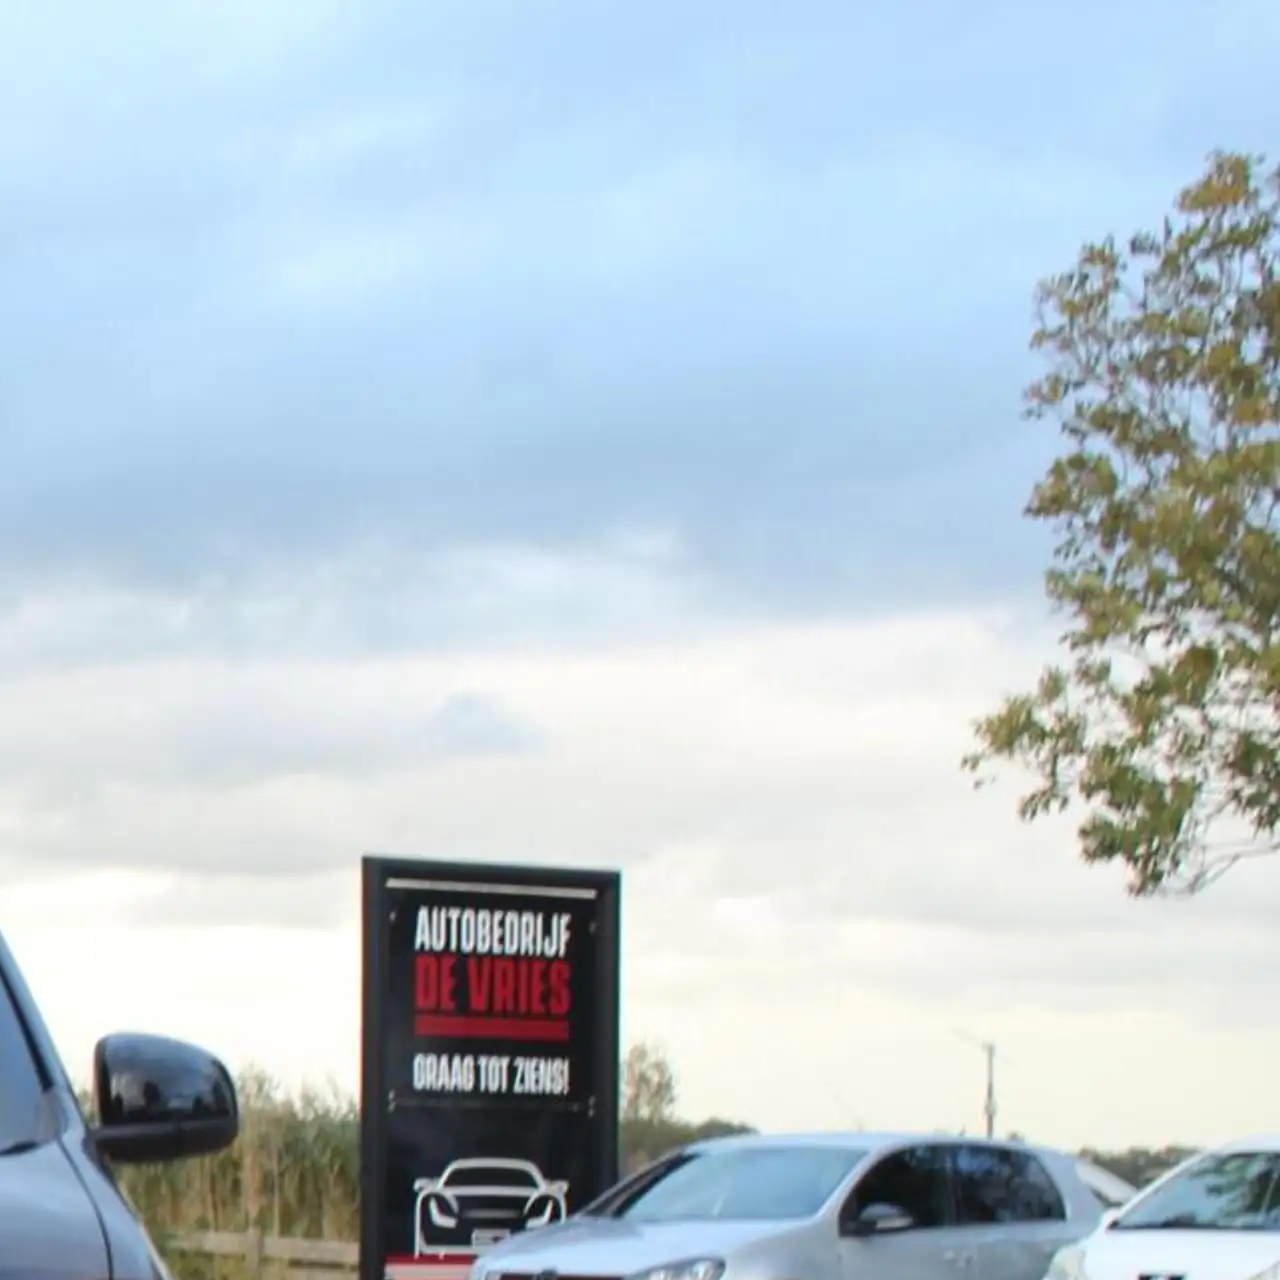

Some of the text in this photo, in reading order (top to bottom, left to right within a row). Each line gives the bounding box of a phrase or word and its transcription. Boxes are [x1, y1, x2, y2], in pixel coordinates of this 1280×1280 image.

[414, 905, 571, 958] AUTOBEDRIJF
[415, 953, 571, 1014] DE VRIES
[478, 1053, 510, 1093] TOT
